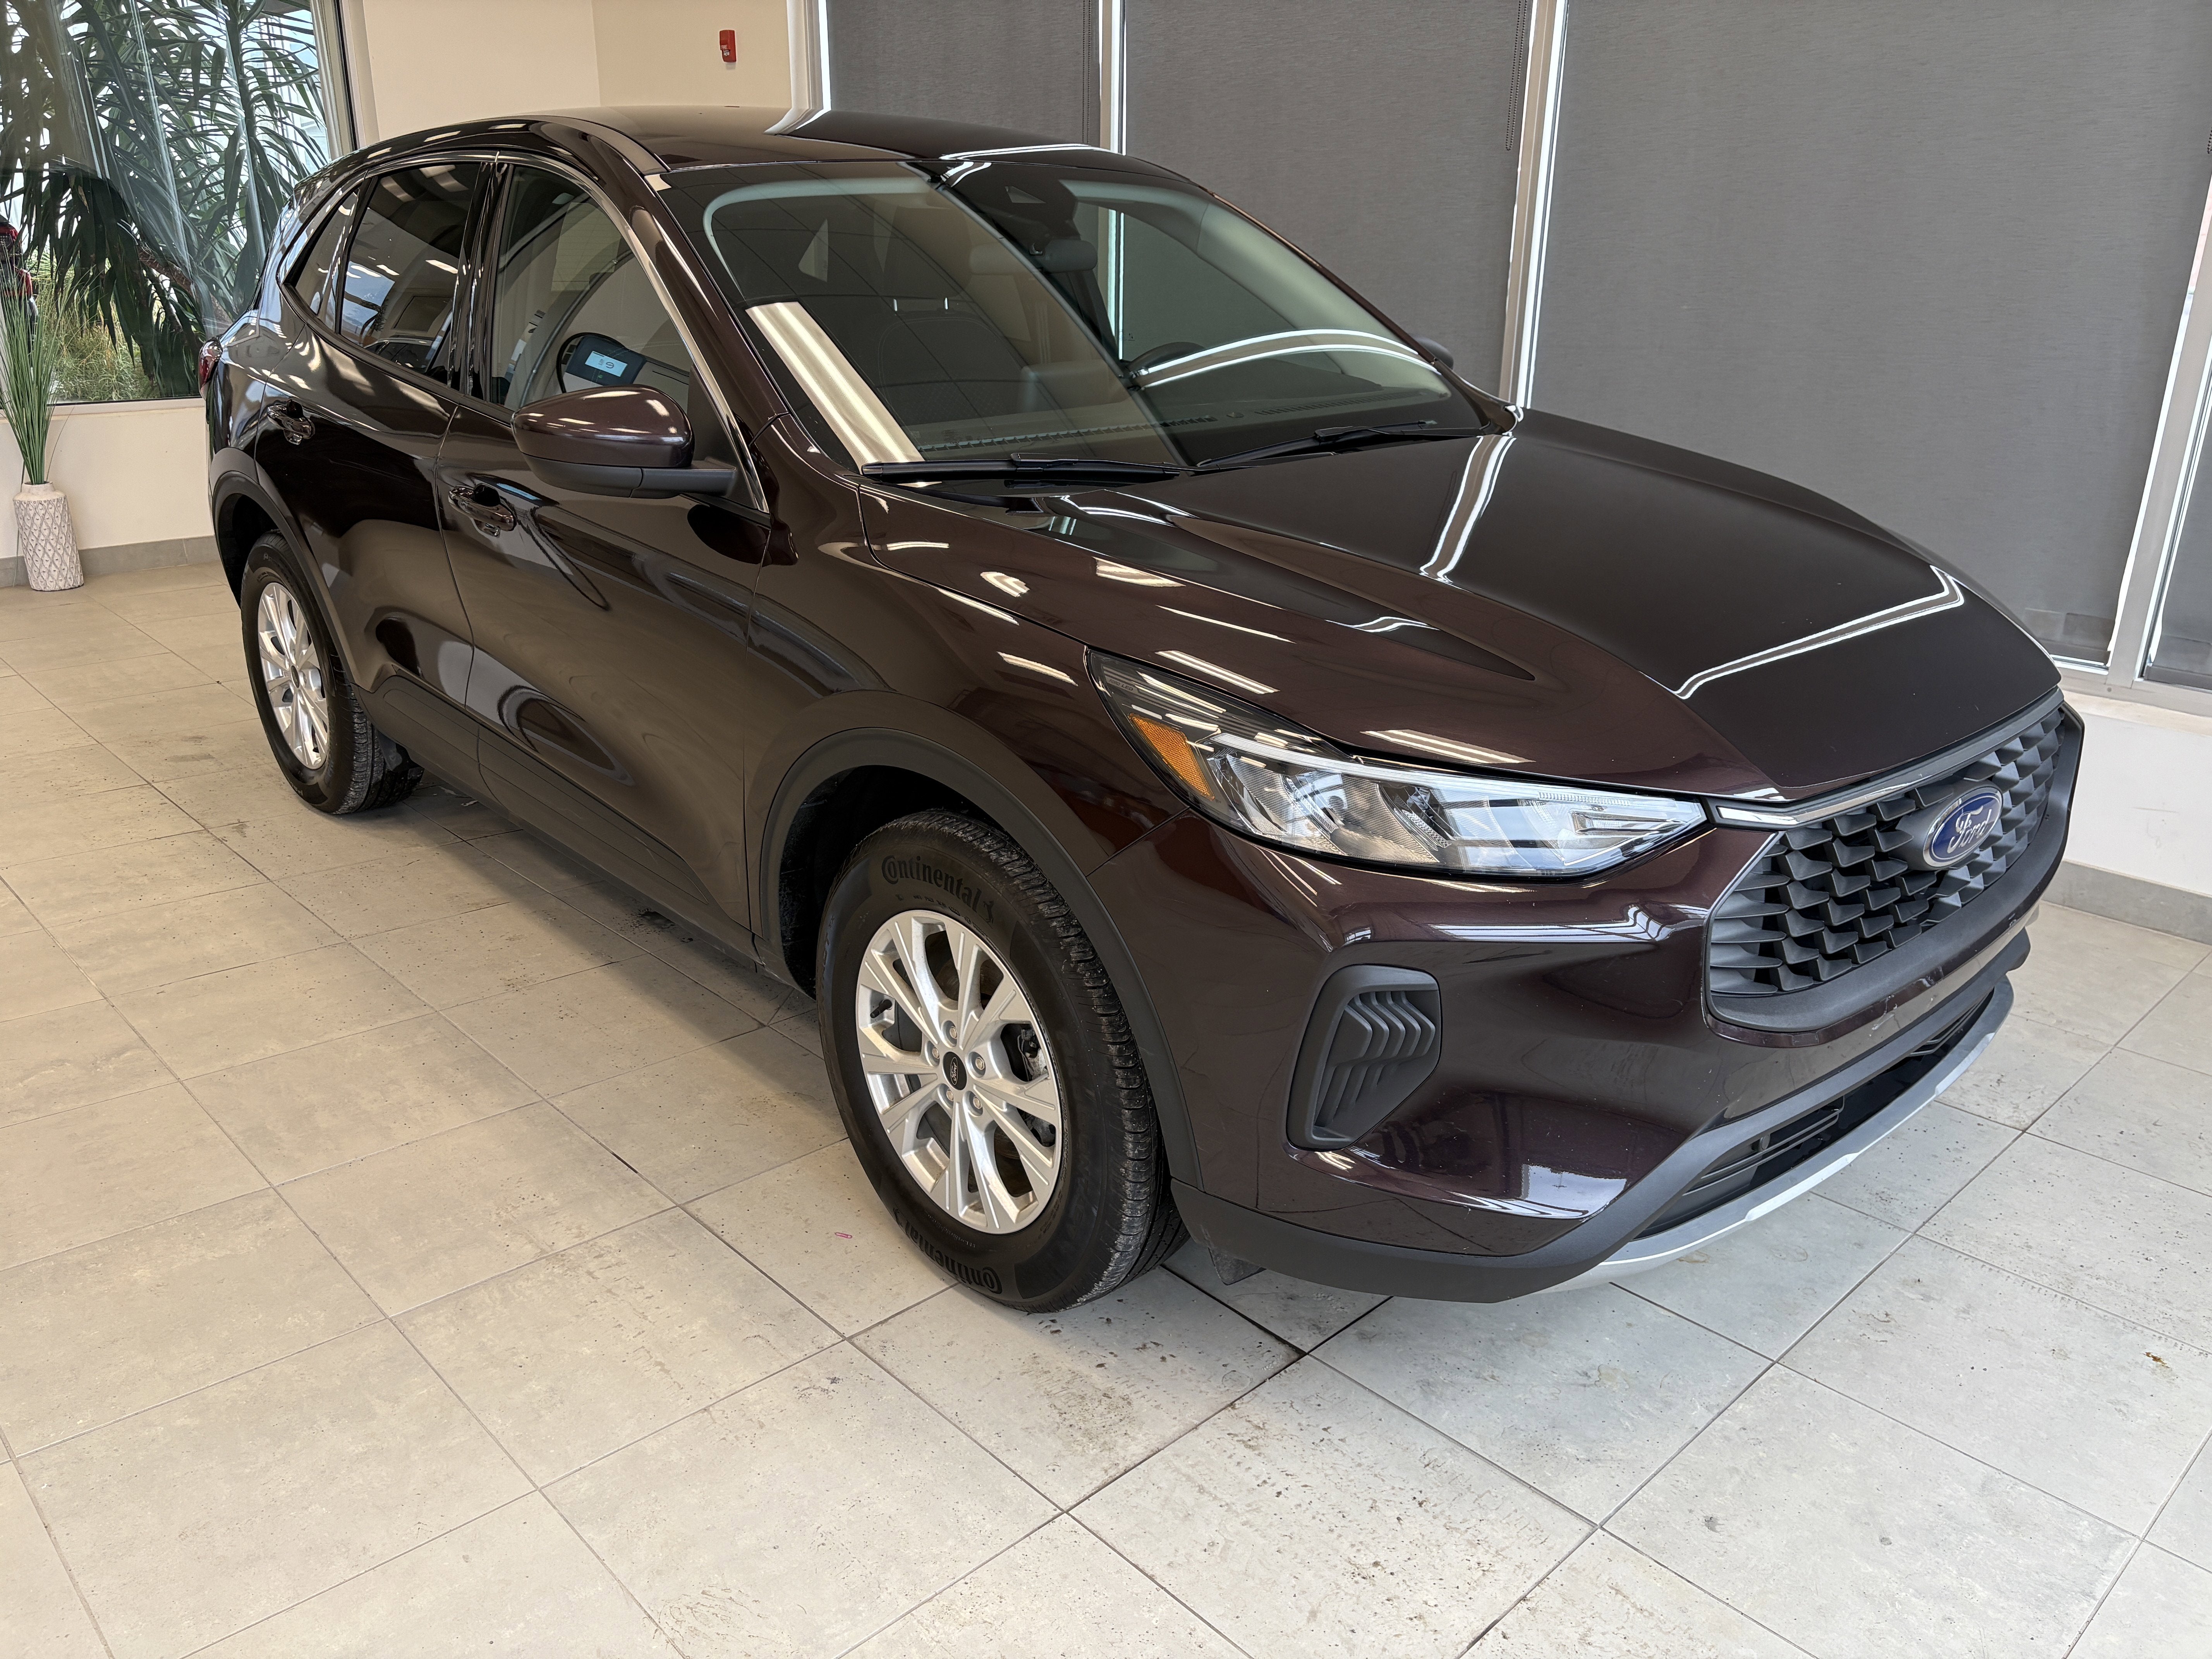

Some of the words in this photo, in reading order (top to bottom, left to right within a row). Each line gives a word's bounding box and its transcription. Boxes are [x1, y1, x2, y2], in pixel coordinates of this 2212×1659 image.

[1947, 805, 1992, 854] Ford
[881, 855, 982, 913] Continental
[905, 1220, 1003, 1294] Continental
